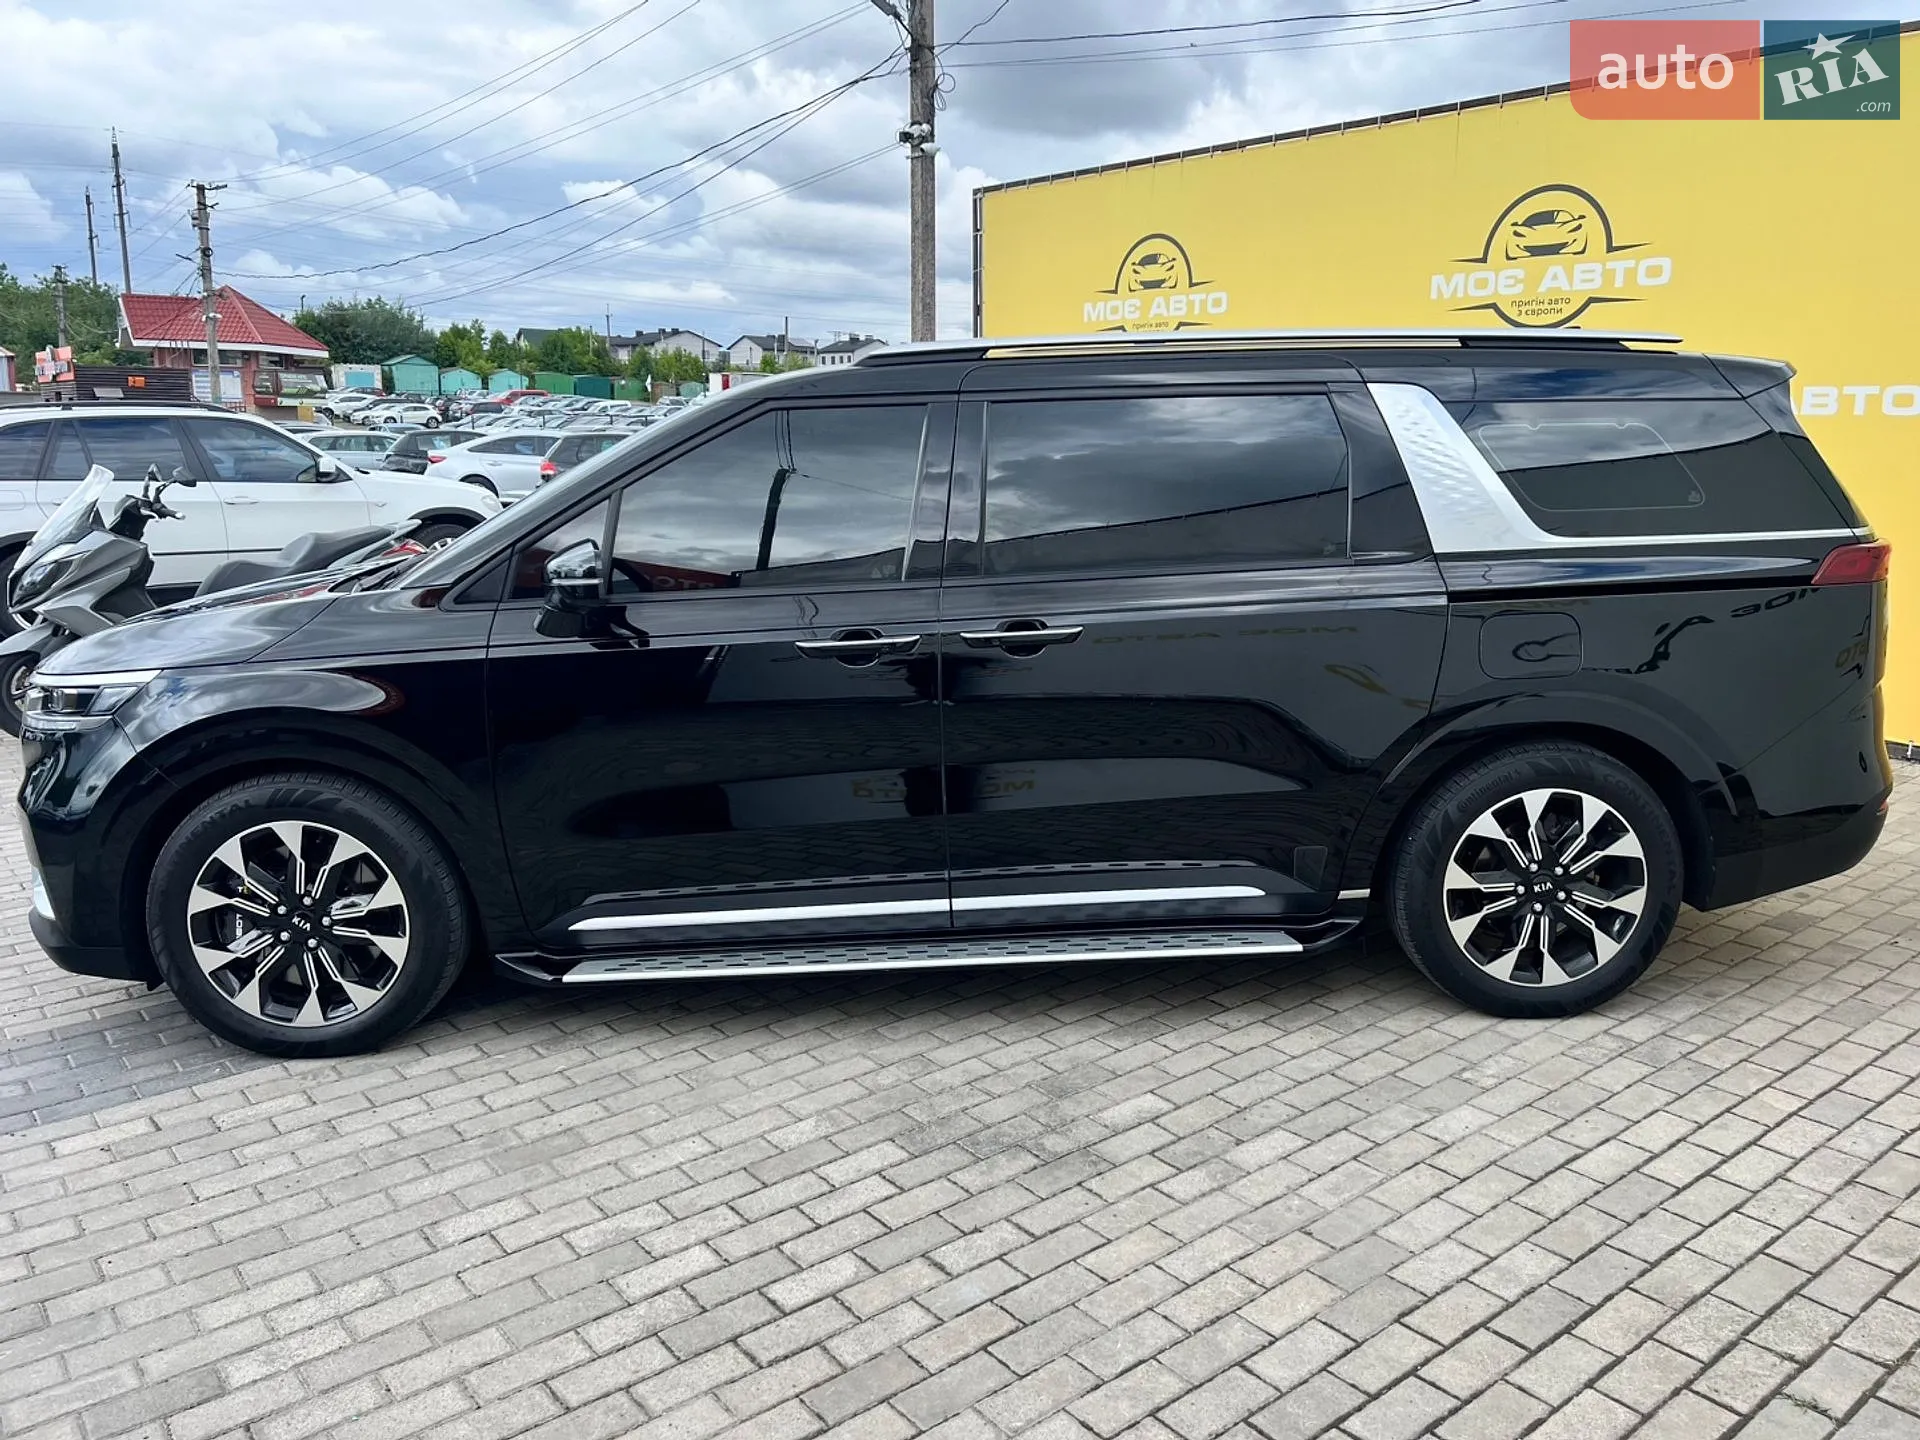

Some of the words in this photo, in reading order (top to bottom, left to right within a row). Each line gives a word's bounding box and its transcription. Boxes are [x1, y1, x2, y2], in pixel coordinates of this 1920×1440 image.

[1429, 268, 1524, 300] МОЄ
[1537, 257, 1672, 293] АВТО
[1083, 299, 1142, 323] МОЄ
[1148, 291, 1229, 319] АВТО
[1547, 297, 1571, 306] авто
[1791, 385, 1920, 416] ВТО
[1533, 881, 1554, 893] KIA
[292, 914, 311, 931] KIA
